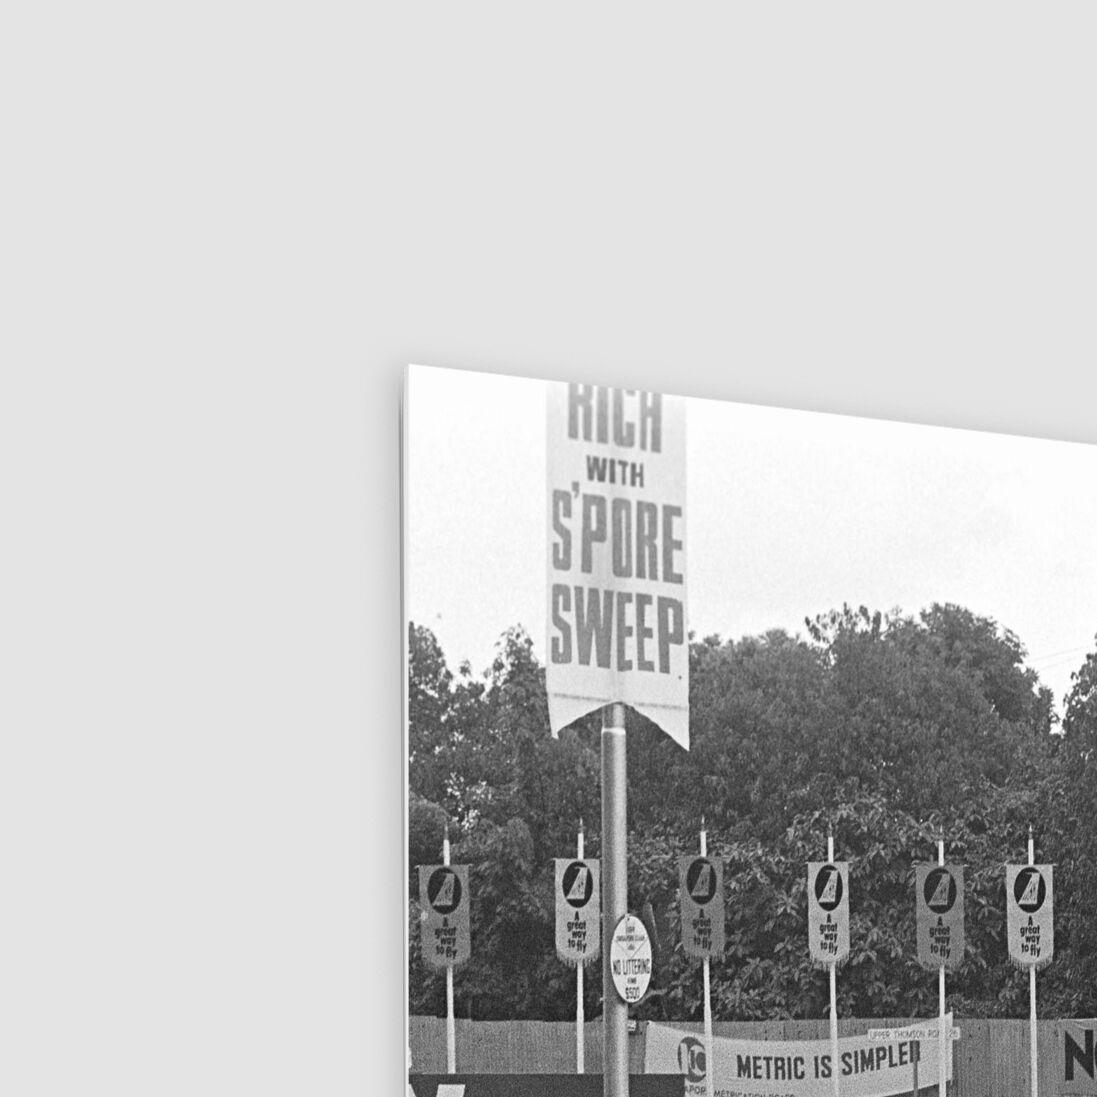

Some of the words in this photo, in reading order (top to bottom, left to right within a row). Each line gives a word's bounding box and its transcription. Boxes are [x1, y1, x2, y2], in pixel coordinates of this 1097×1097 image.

[568, 383, 662, 453] RICH
[586, 455, 645, 488] WITH
[552, 481, 684, 585] S'PORE
[551, 583, 684, 675] SWEEP
[567, 920, 586, 932] great
[820, 922, 838, 935] great
[1020, 925, 1040, 937] great
[572, 930, 586, 940] way
[824, 932, 838, 943] way
[1025, 935, 1040, 945] way
[568, 938, 576, 948] to
[577, 939, 587, 954] fly
[820, 940, 828, 950] to
[829, 941, 838, 956] fly
[1021, 943, 1029, 953] to
[1030, 944, 1041, 957] fly
[613, 960, 621, 975] NO
[623, 959, 650, 975] LITTERING
[736, 1054, 805, 1081] METRIC
[814, 1055, 832, 1079] IS
